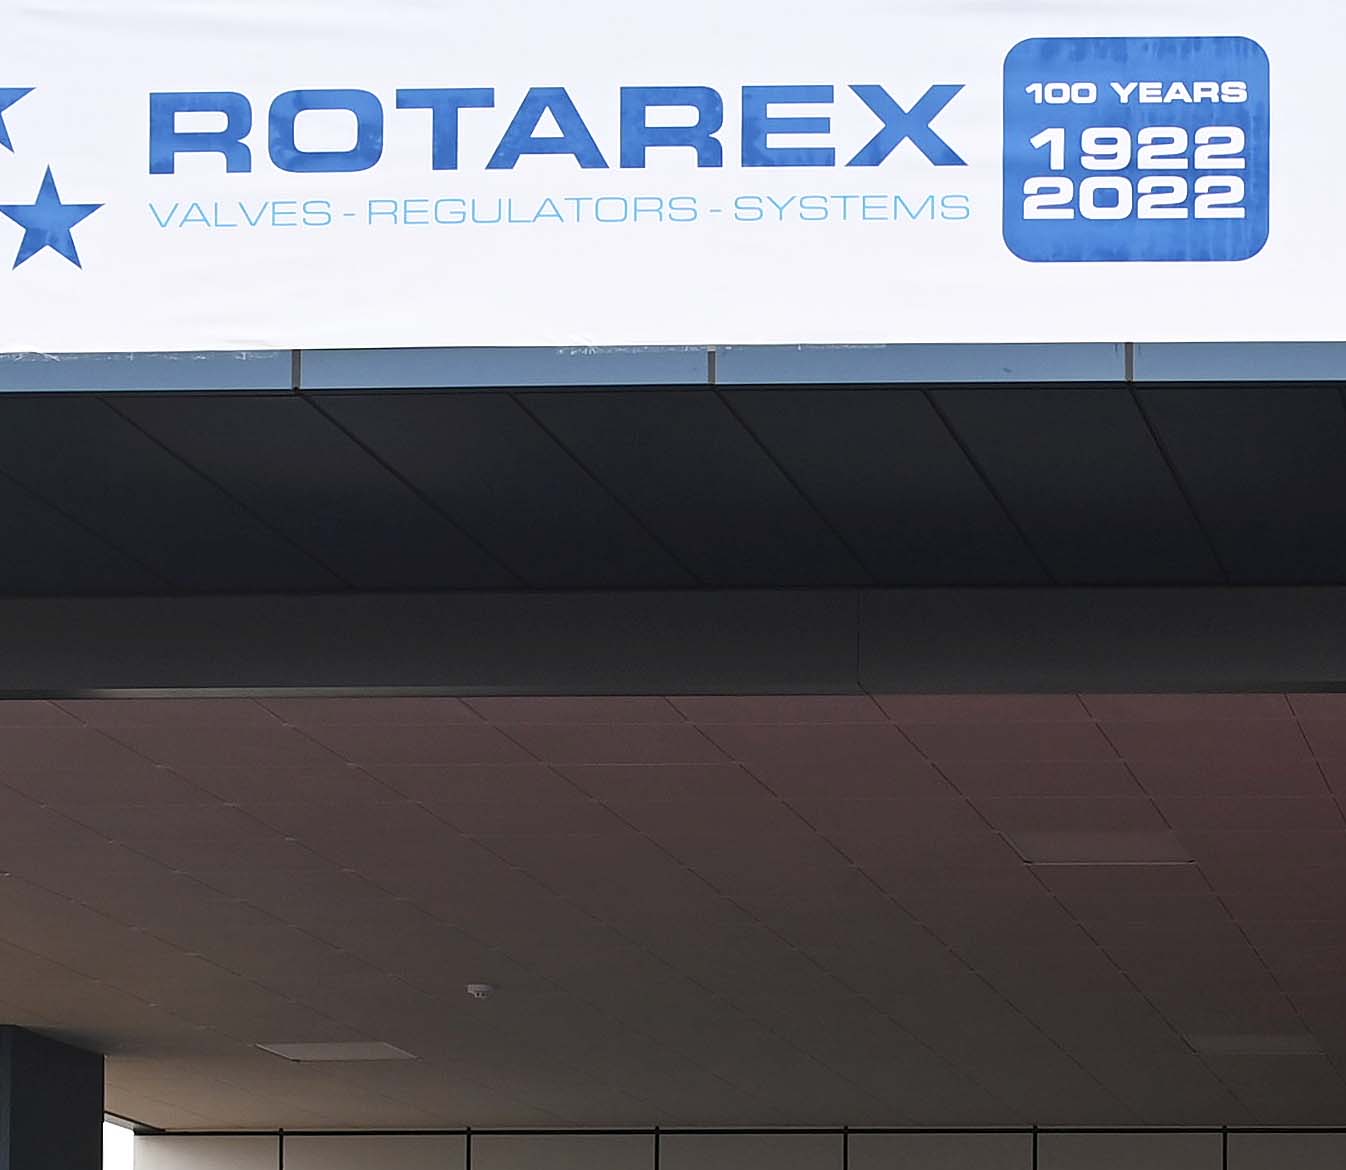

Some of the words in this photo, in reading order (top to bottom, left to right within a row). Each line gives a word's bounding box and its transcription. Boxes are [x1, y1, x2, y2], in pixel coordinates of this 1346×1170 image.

[1026, 82, 1097, 104] 100
[1110, 82, 1247, 104] YEARS
[149, 84, 967, 175] ROTAREX
[1030, 126, 1247, 170] 1922
[150, 199, 332, 228] VALVES
[368, 196, 698, 226] REGULATORS
[735, 194, 971, 222] SYSTEMS
[1023, 175, 1247, 220] 2022
